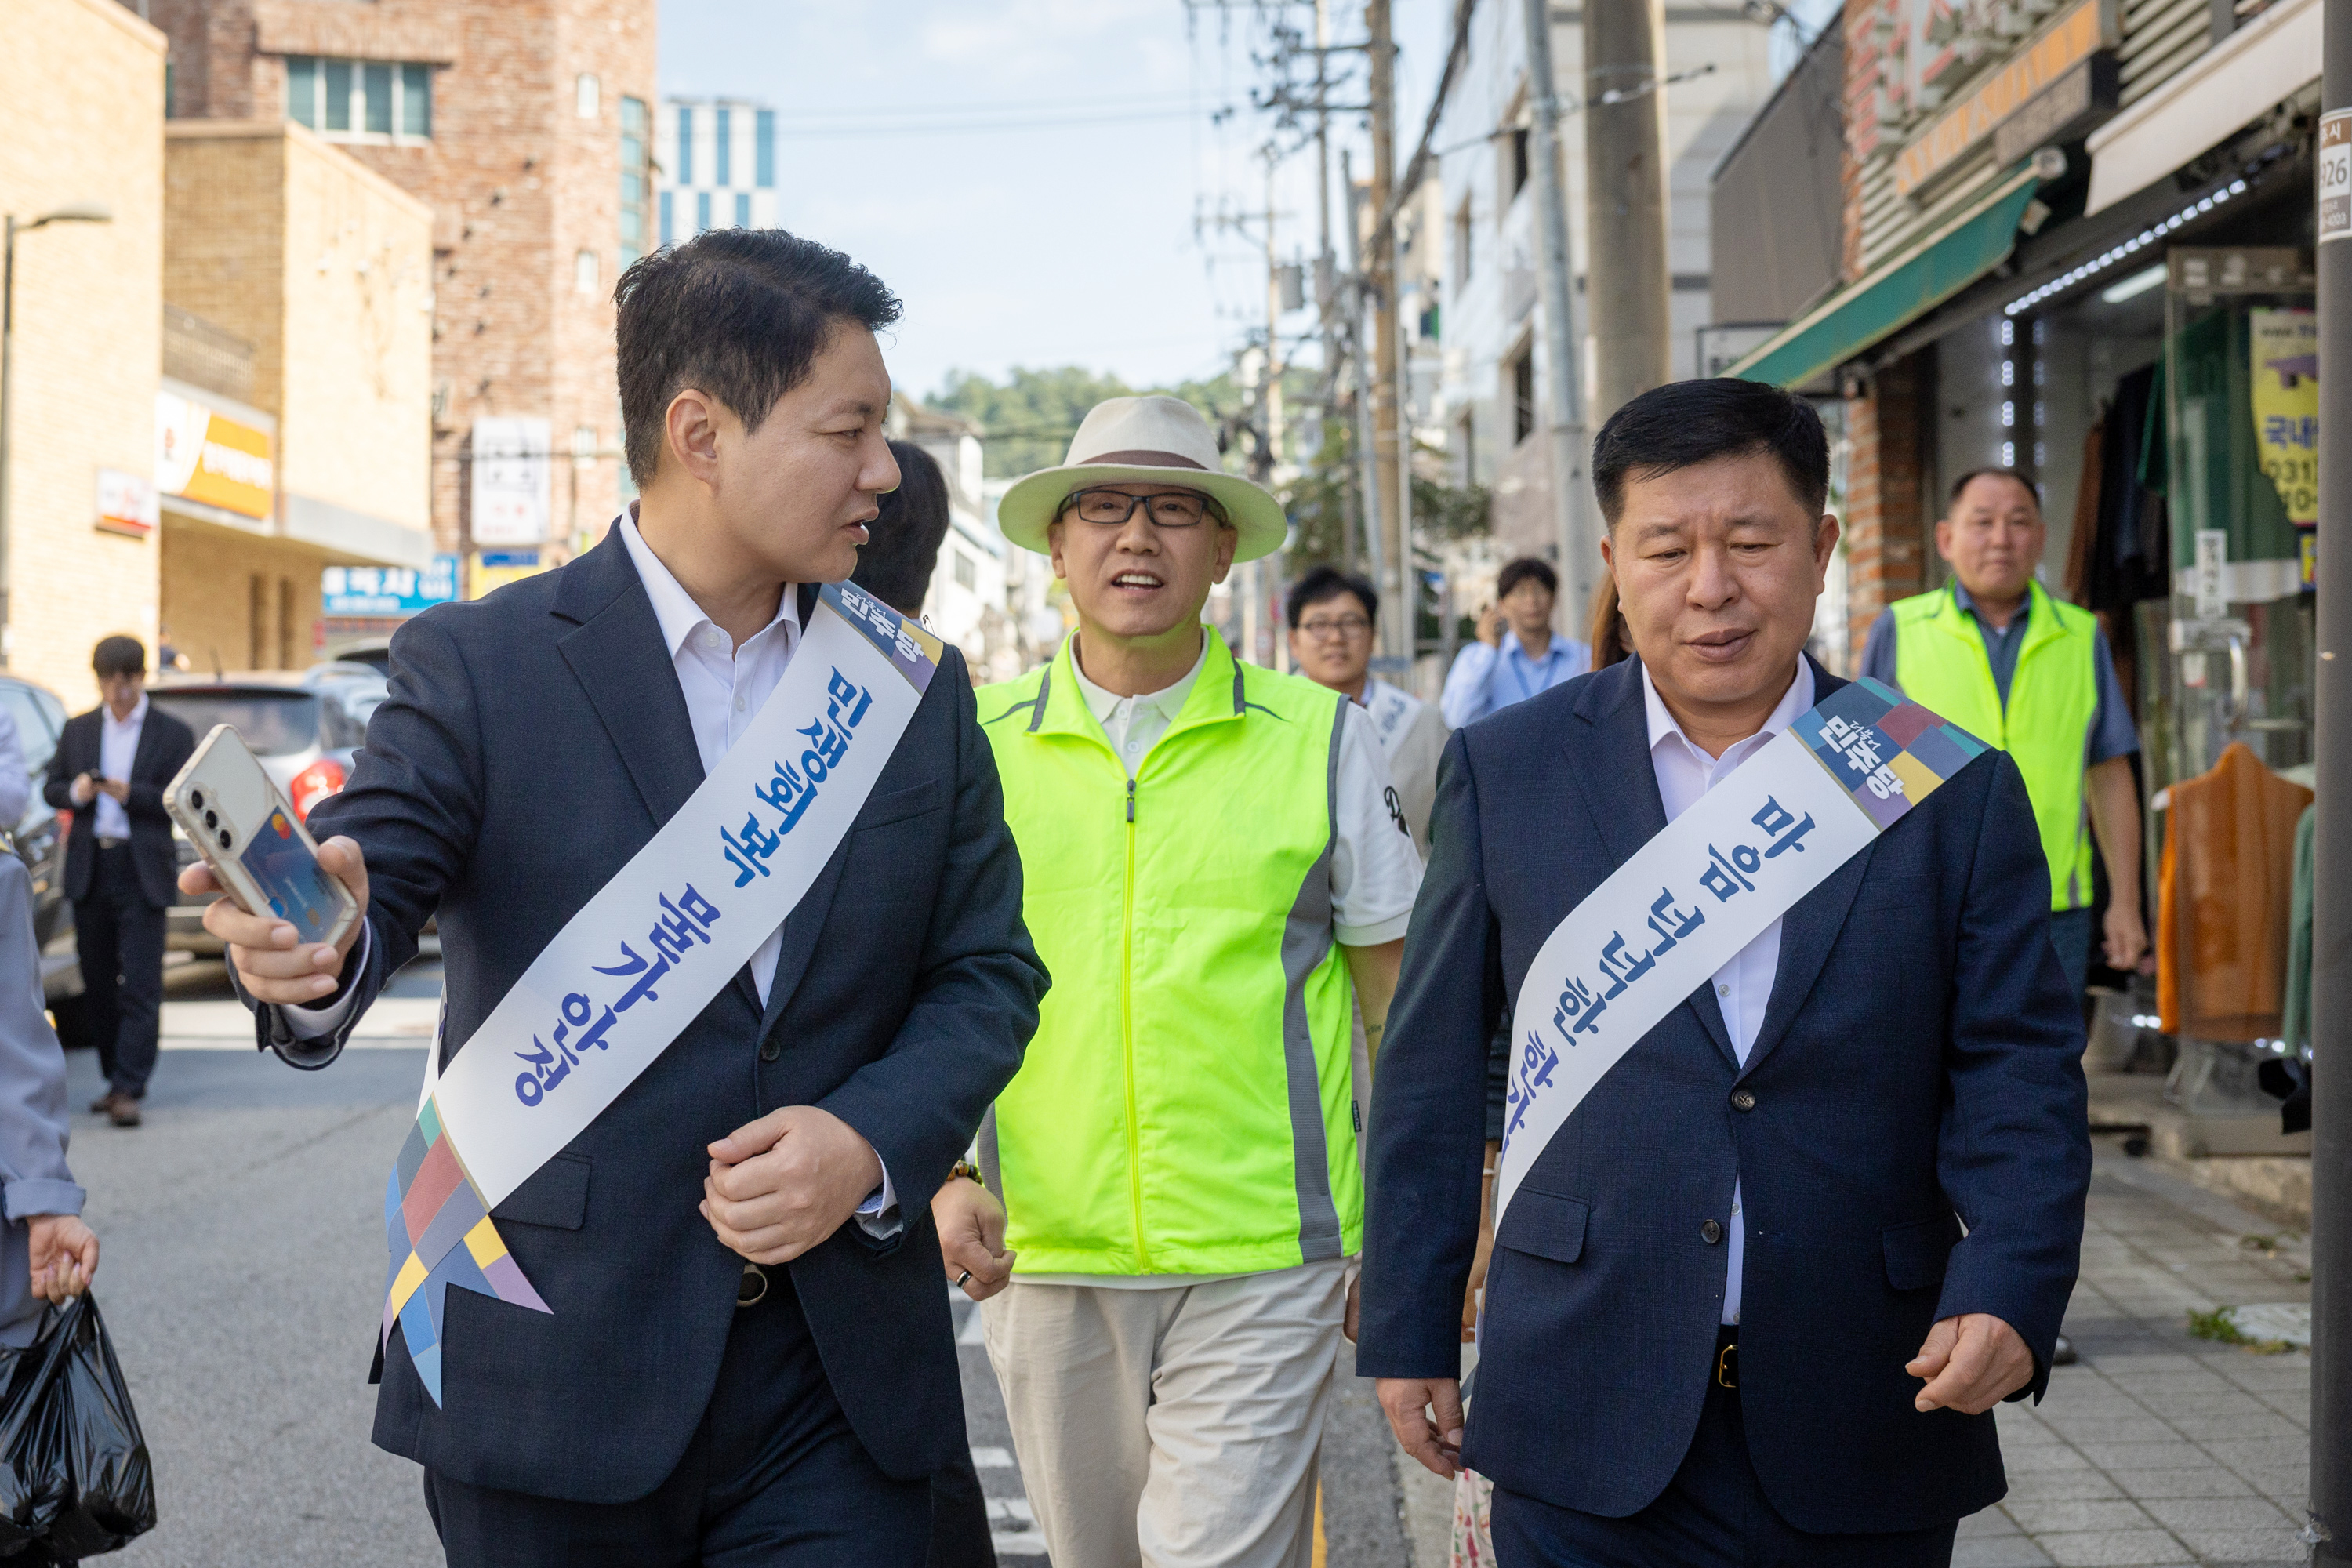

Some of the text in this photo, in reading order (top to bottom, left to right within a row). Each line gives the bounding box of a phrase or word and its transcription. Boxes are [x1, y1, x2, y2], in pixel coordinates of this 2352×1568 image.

[2266, 415, 2318, 451] 국내
[840, 588, 924, 662] 민주당
[856, 593, 886, 617] 더불어
[1819, 715, 1904, 800] 민주당
[1849, 720, 1880, 750] 더불어
[514, 666, 873, 1107] 민생회복 물가안정
[1501, 795, 1815, 1162] 마음 넉넉한 한가
